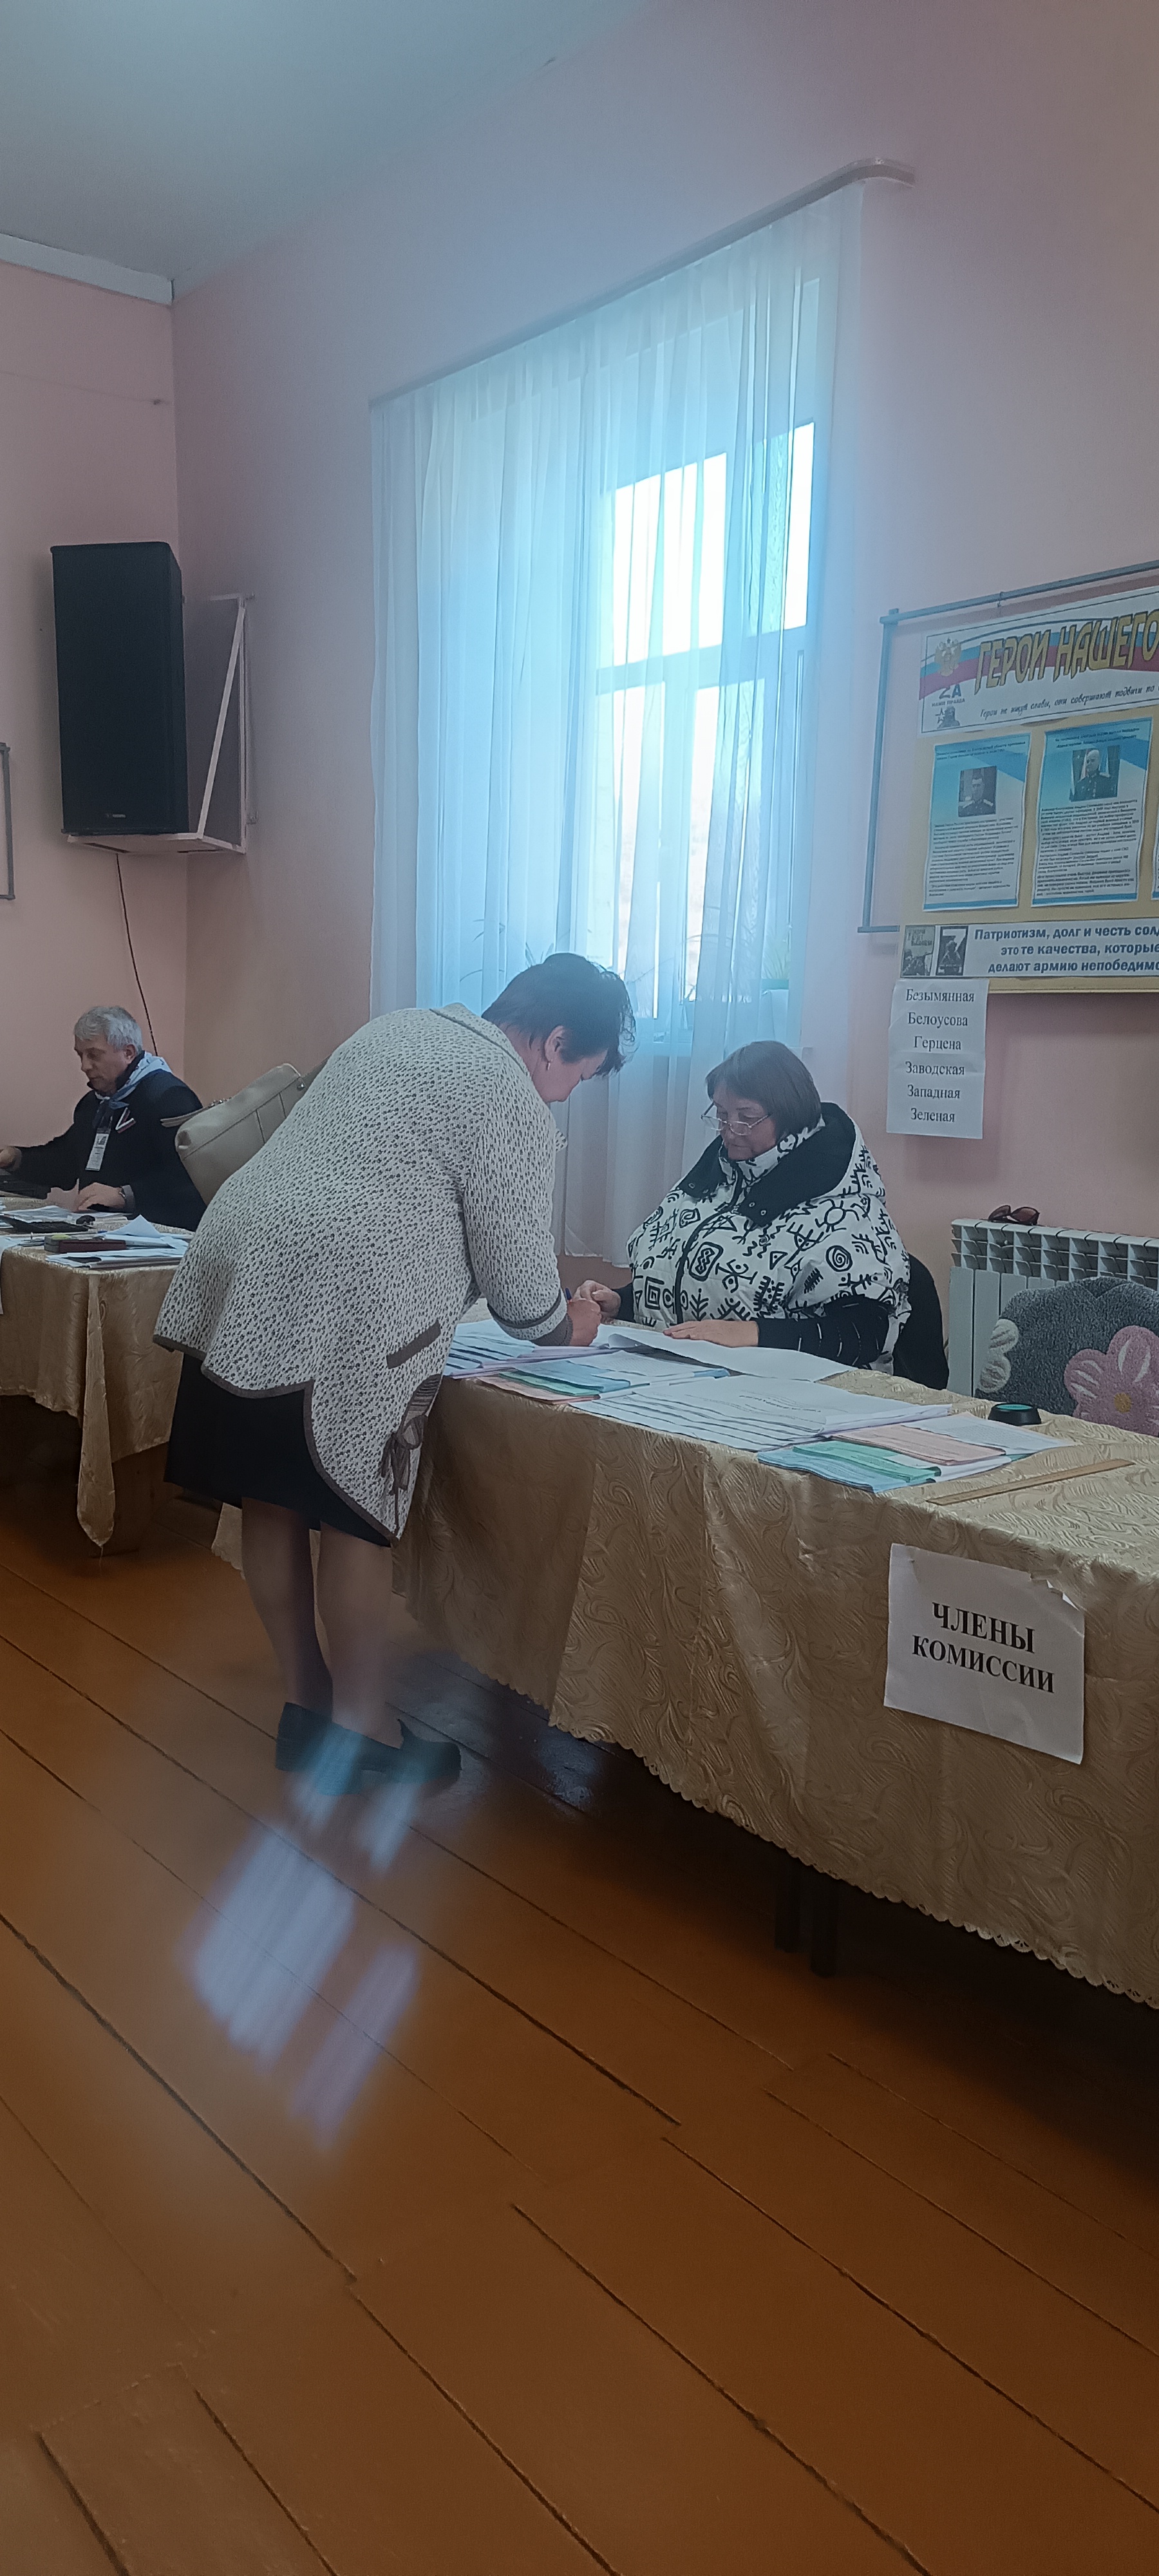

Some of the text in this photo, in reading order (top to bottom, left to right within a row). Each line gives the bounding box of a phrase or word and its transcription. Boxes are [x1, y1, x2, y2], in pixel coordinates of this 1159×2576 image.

[974, 609, 1159, 695] ГЕРОИ НАШЕГО
[980, 709, 997, 720] Герои
[1031, 699, 1051, 709] славы,
[1054, 697, 1067, 706] они
[1071, 690, 1112, 706] совершают
[1115, 687, 1142, 697] подвиги
[975, 927, 1050, 940] Патриотизм,
[1053, 929, 1081, 939] долг
[1084, 928, 1091, 936] и
[1095, 927, 1131, 936] честь
[1001, 946, 1019, 956] это
[1021, 945, 1034, 955] те
[1037, 944, 1100, 956] качества,
[988, 961, 1030, 973] делают
[1033, 962, 1078, 973] армию
[906, 989, 975, 1003] Безымянная
[908, 1012, 968, 1028] Белоусова
[914, 1036, 961, 1052] Герцена
[905, 1061, 965, 1076] Заводская
[907, 1084, 961, 1099] Западная
[910, 1108, 956, 1123] Зеленая
[932, 1602, 1035, 1654] ЧЛЕНЫ
[912, 1634, 1055, 1694] КОМИССИИ
